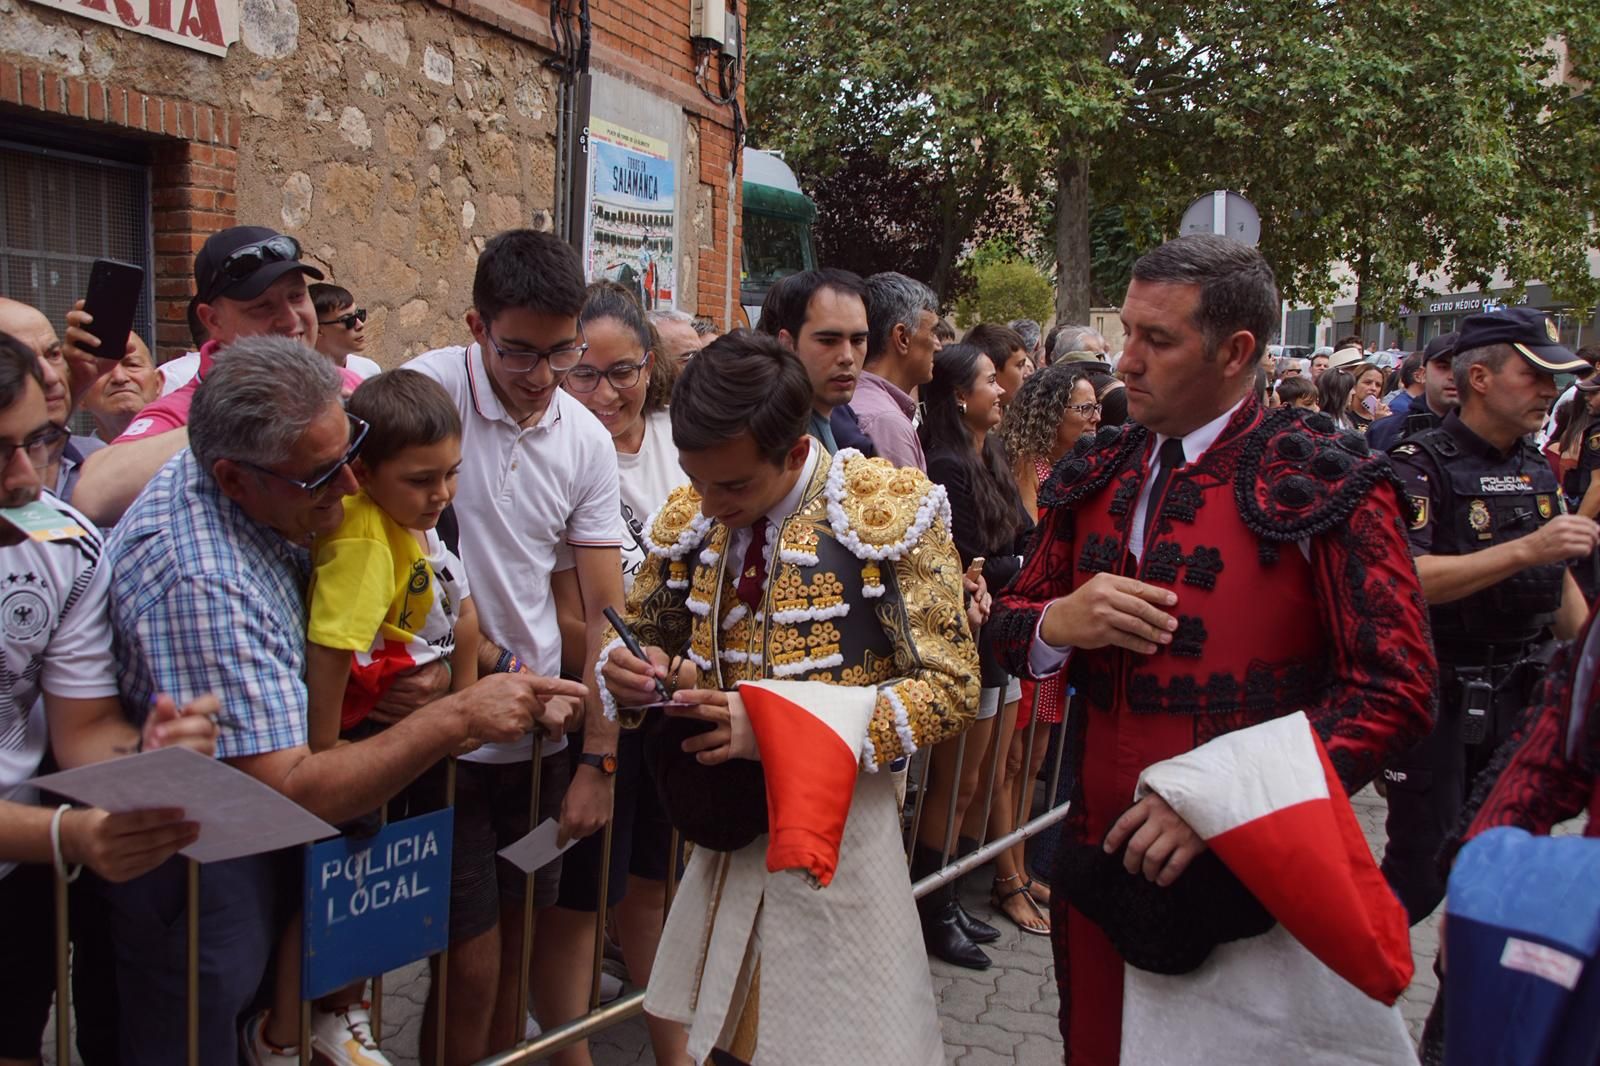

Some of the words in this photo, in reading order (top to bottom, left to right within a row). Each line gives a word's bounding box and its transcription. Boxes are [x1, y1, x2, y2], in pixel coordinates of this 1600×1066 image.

[612, 165, 659, 200] SALAMANCA
[1430, 301, 1453, 312] CENTRO
[1455, 299, 1480, 311] MÉDICO
[1481, 484, 1533, 492] NACIONAL
[1383, 768, 1408, 783] CNP
[321, 830, 439, 891] POLICIA
[327, 871, 431, 926] LOCAL
